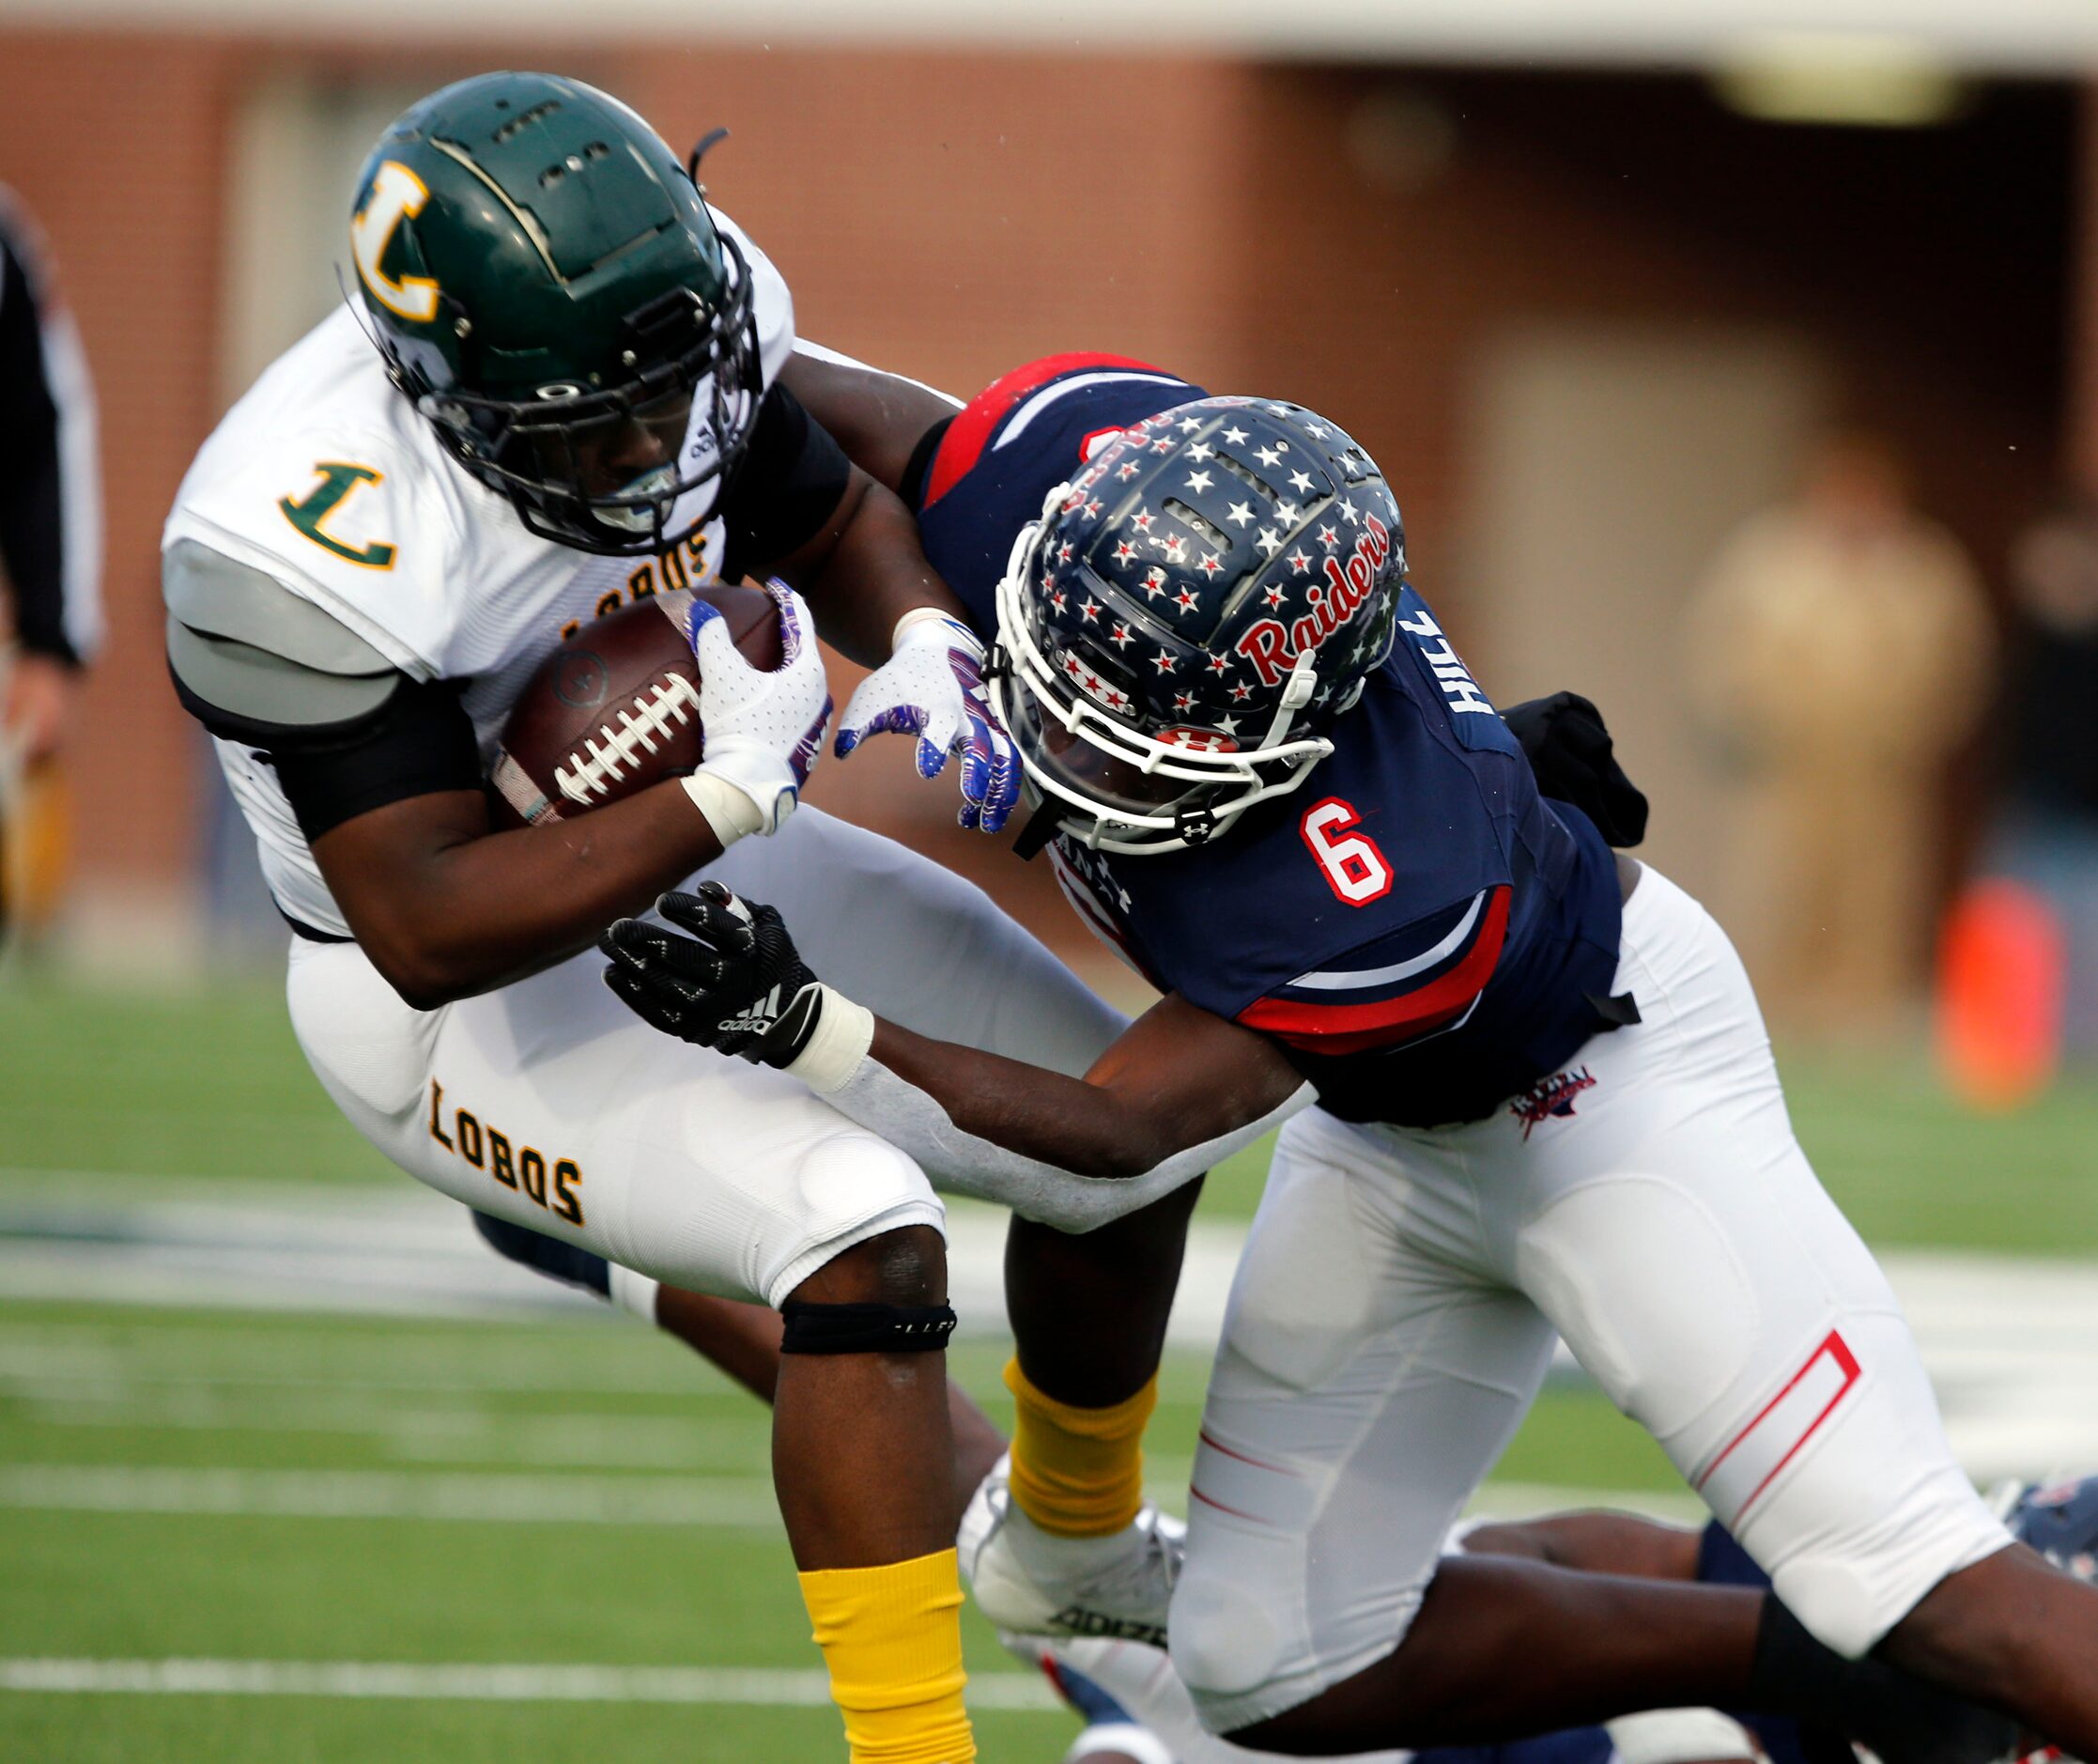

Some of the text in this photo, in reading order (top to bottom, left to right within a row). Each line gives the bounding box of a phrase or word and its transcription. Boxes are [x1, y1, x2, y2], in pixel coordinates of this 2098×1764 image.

[350, 160, 440, 322] L
[277, 461, 398, 571] L
[1234, 510, 1391, 688] Raiders
[1396, 610, 1496, 716] HILL
[1298, 796, 1395, 908] 6
[717, 1016, 772, 1036] adida
[428, 1075, 586, 1229] LOBOS
[1045, 1604, 1168, 1652] ADIZE
